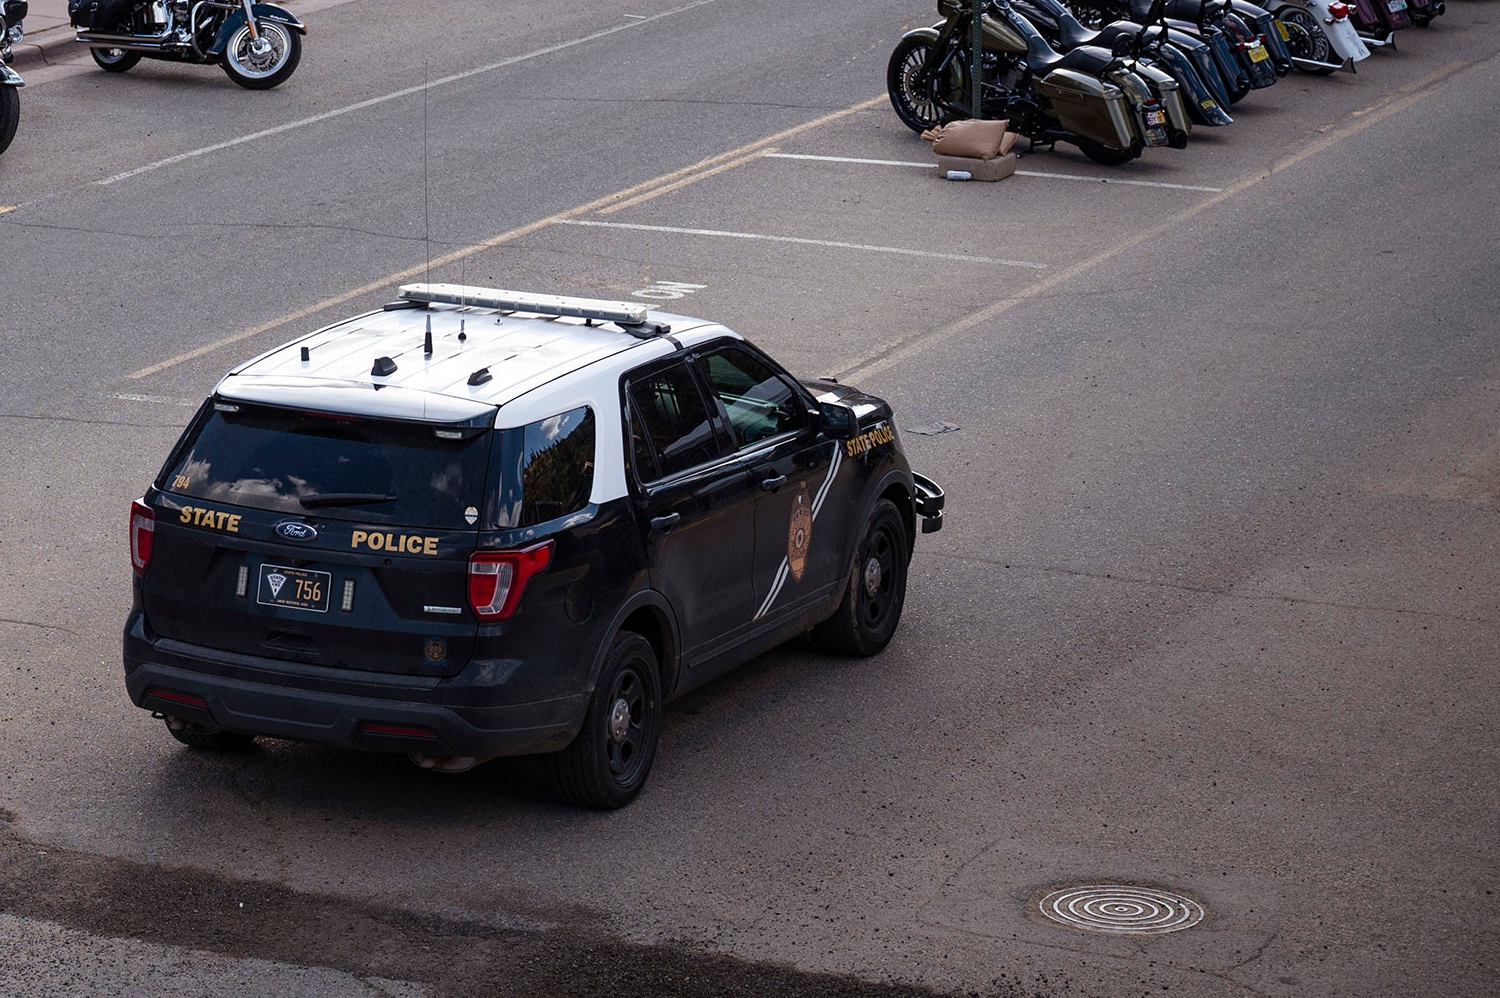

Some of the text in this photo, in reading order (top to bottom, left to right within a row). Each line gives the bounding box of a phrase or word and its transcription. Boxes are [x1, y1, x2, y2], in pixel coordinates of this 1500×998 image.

[846, 425, 895, 458] STATE POLICE
[171, 474, 191, 490] 794
[179, 505, 242, 532] STATE
[352, 530, 439, 555] POLICE
[295, 579, 321, 602] 756
